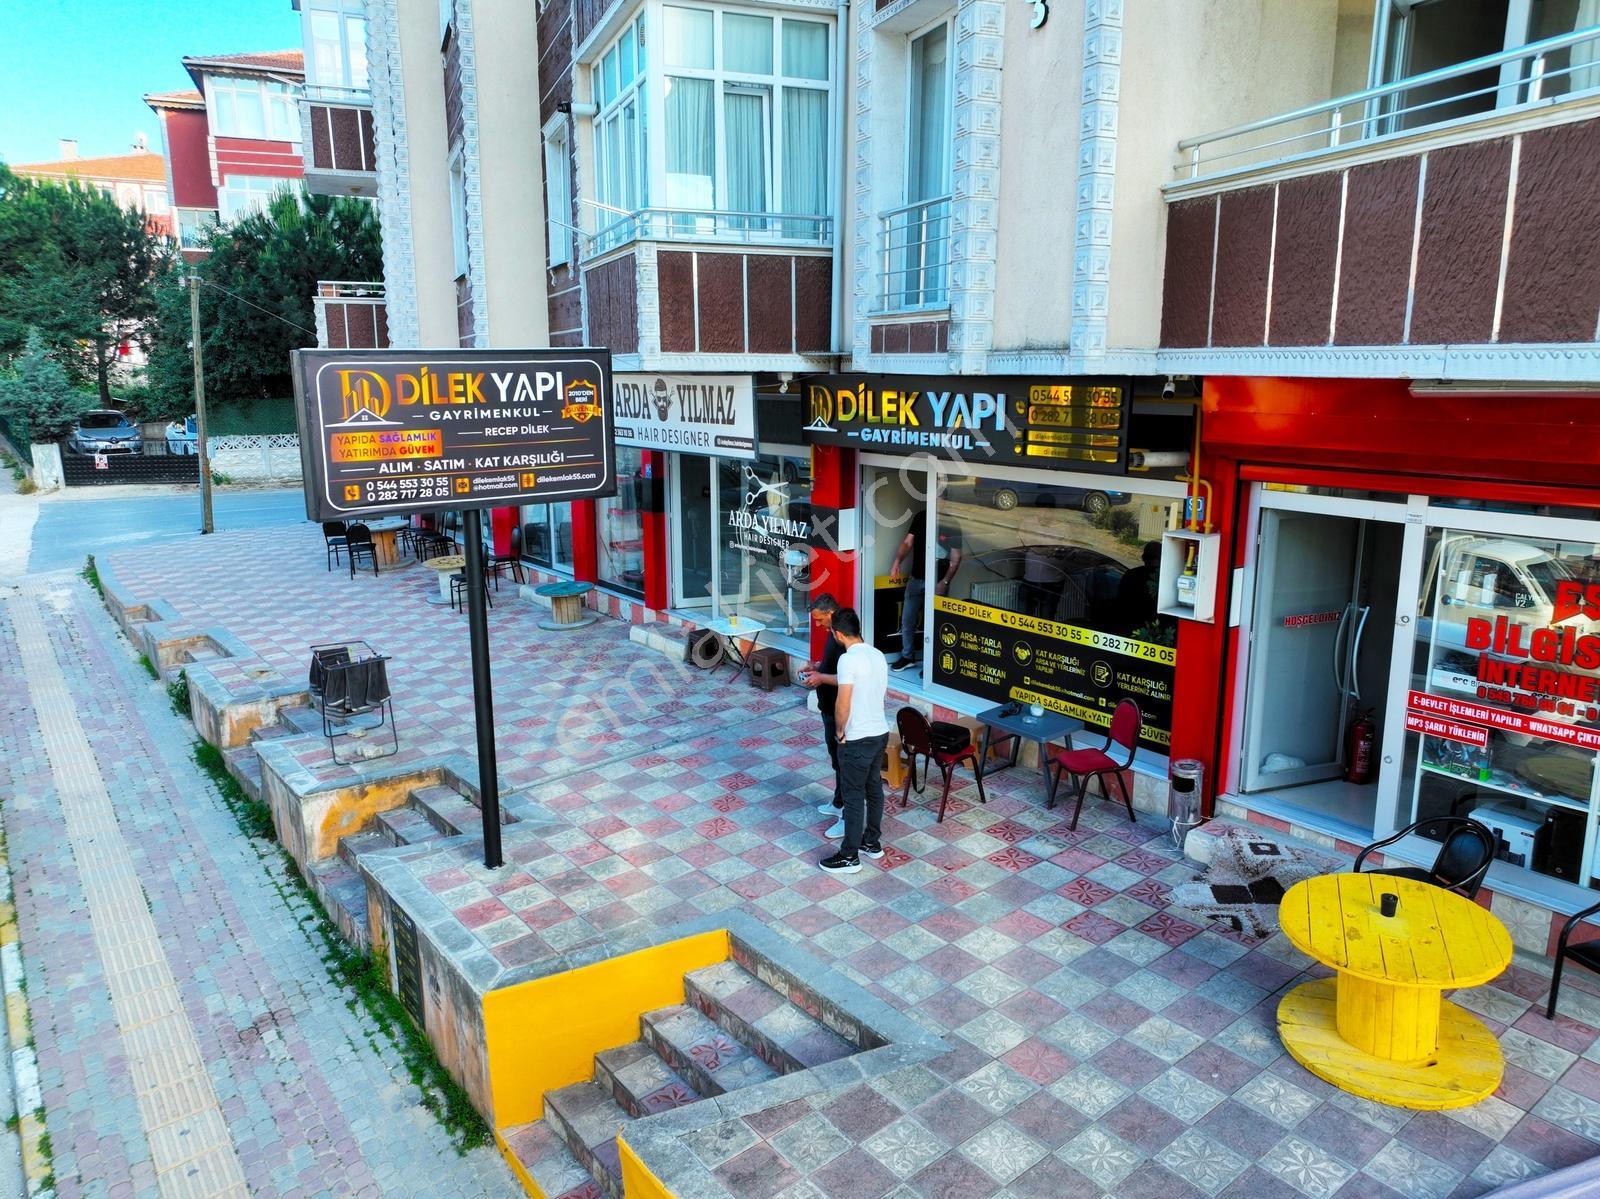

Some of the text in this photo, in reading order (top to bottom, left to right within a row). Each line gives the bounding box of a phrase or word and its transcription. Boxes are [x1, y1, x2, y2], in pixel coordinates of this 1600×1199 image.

[395, 366, 563, 406] DİLEK YAPI
[429, 408, 540, 421] GAYRİMENKUL
[615, 383, 736, 426] ARDA YILMAZ
[837, 383, 1008, 431] DİLEK YAPI
[337, 431, 437, 446] YAPIDA SAĞLAMLIK
[484, 424, 550, 437] RECEP DİLEK
[637, 427, 660, 444] HAIR
[662, 429, 710, 448] DESIGNER
[860, 427, 974, 450] GAYRİMENKUL
[339, 443, 435, 458] YATIRIMDA GÜVEN
[379, 451, 565, 474] ALIM SATIM KAT KARŞILIĞI
[366, 477, 449, 491] 0 544 553 30 55
[473, 474, 516, 485] dilekemlak55
[536, 472, 596, 484] dilekemlak55.com
[367, 487, 449, 501] 0 282 717 28 05
[728, 510, 807, 539] ARDA YILMAZ
[744, 531, 759, 544] HAIR
[759, 535, 790, 549] DESIGNER
[941, 600, 967, 613] RECEP
[969, 606, 992, 620] DİLEK
[1010, 615, 1016, 625] 0
[1018, 617, 1035, 630] 544
[1037, 621, 1053, 633] 553
[1056, 625, 1068, 637] 30
[1070, 629, 1082, 640] 55
[1092, 634, 1100, 644] 0
[1102, 637, 1121, 650] 282
[1123, 641, 1140, 654] 717
[1142, 645, 1156, 658] 28
[1159, 649, 1174, 662] 05
[1116, 672, 1130, 682] KAT
[1043, 695, 1088, 718] SAĞLAMLIK
[1413, 695, 1447, 712] E-DEVLET
[1449, 701, 1489, 721] İŞLEMLERİ
[1491, 712, 1522, 728] YAPILIR
[1529, 720, 1575, 739] WHATSAPP
[1407, 715, 1486, 742] MP3 ŞARKI YÜKLENİR
